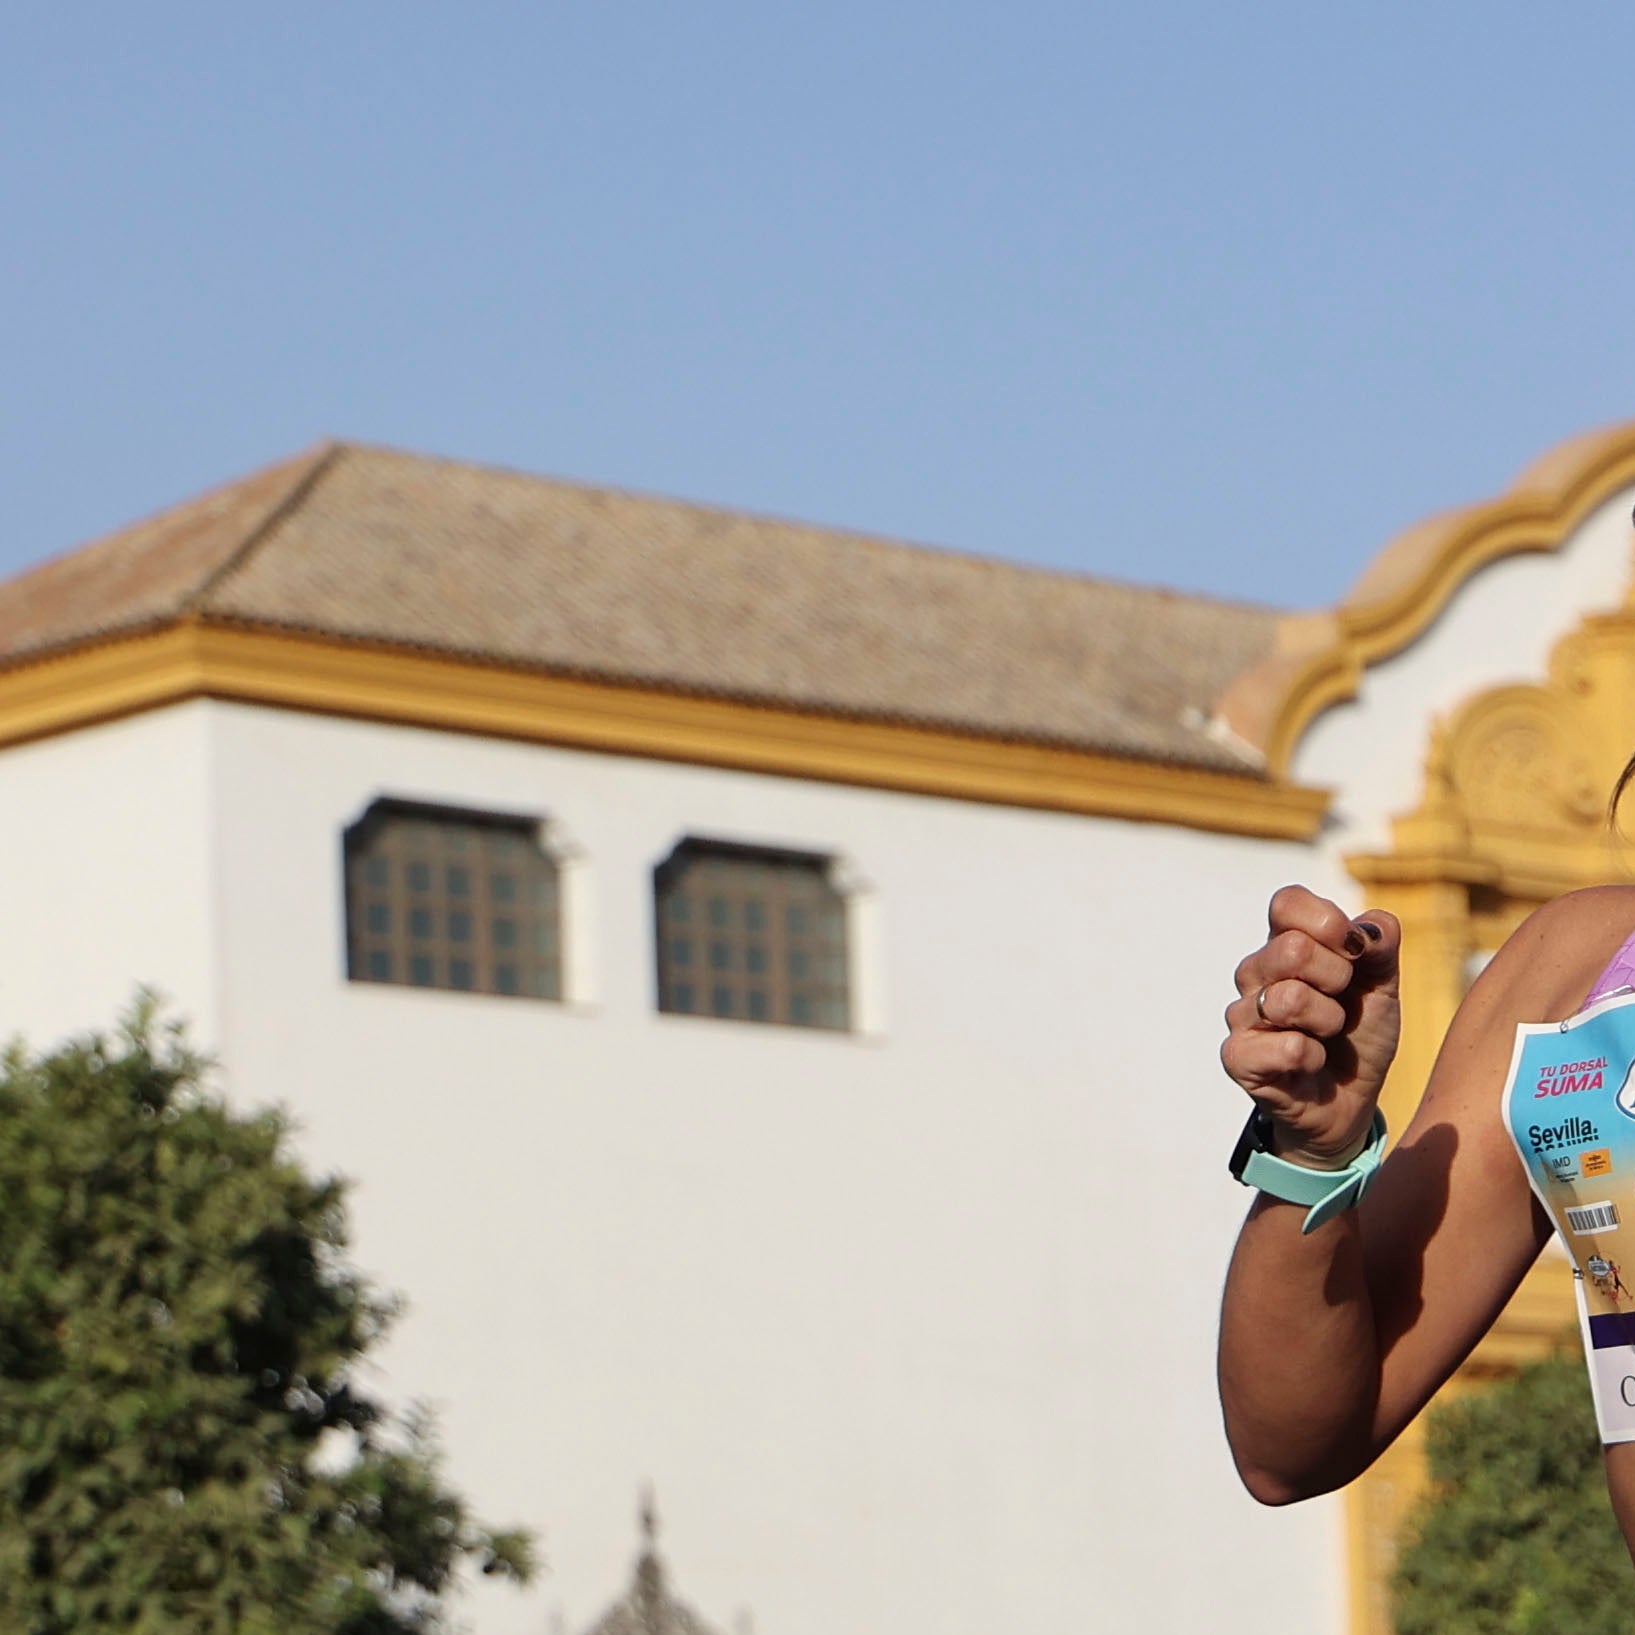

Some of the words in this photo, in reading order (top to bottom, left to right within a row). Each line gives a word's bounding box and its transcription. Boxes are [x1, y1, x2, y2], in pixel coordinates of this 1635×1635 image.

[1540, 1065, 1557, 1078] TU
[1560, 1056, 1608, 1076] DORSAL
[1534, 1071, 1604, 1099] SUMA
[1552, 1156, 1571, 1169] IMD
